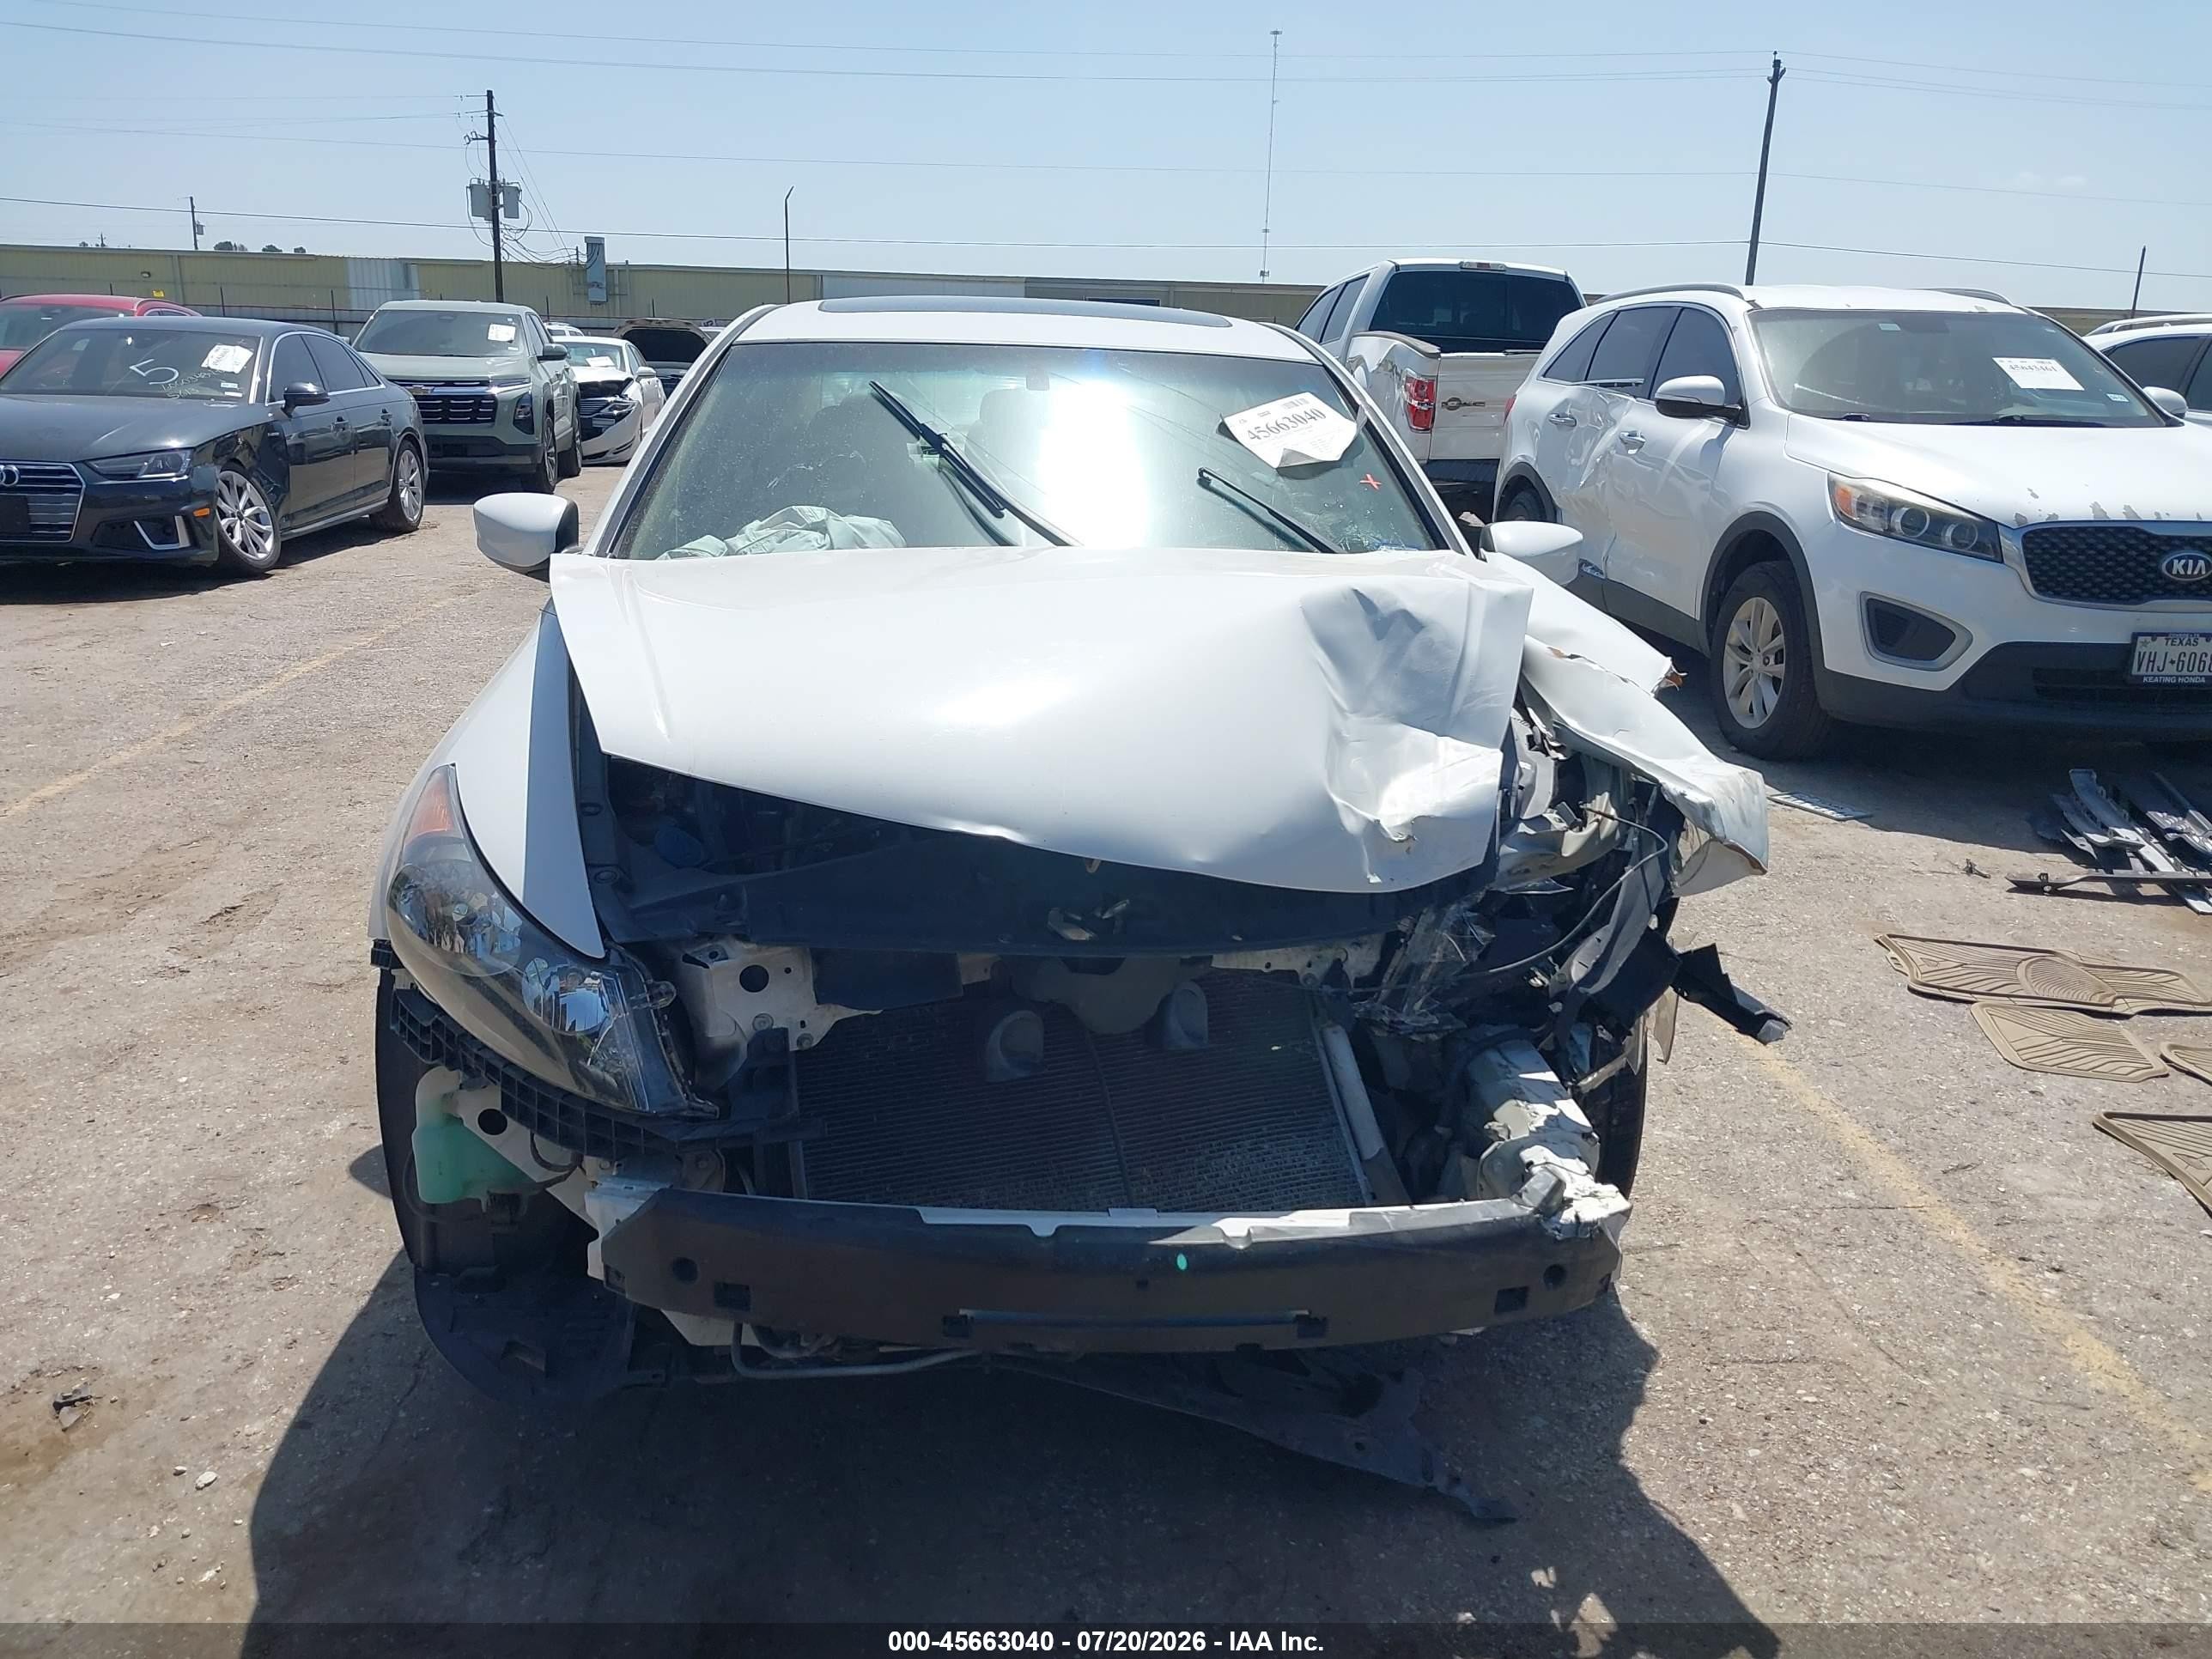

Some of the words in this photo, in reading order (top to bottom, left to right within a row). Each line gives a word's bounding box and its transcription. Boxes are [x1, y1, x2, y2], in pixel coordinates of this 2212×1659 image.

[129, 358, 179, 385] 5
[1248, 408, 1327, 441] 45663040
[2171, 559, 2207, 575] KIA
[2164, 637, 2199, 647] TEXAS
